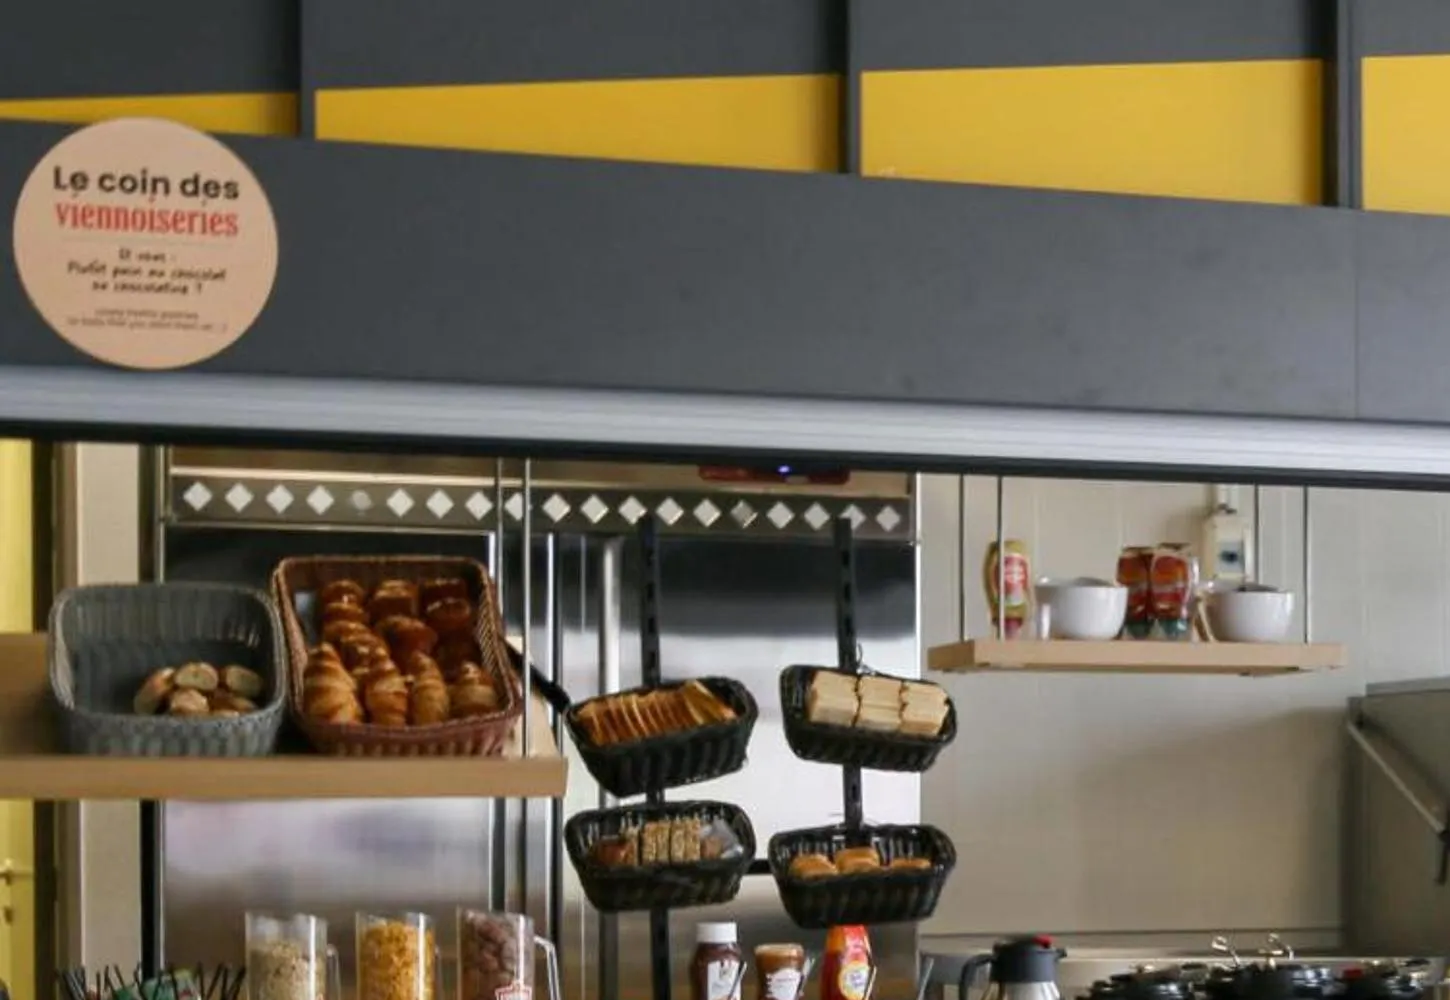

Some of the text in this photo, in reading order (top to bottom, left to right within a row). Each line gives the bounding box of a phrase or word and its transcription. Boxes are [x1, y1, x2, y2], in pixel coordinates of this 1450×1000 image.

[53, 165, 240, 200] Le coin des
[56, 197, 240, 237] viennoiseries
